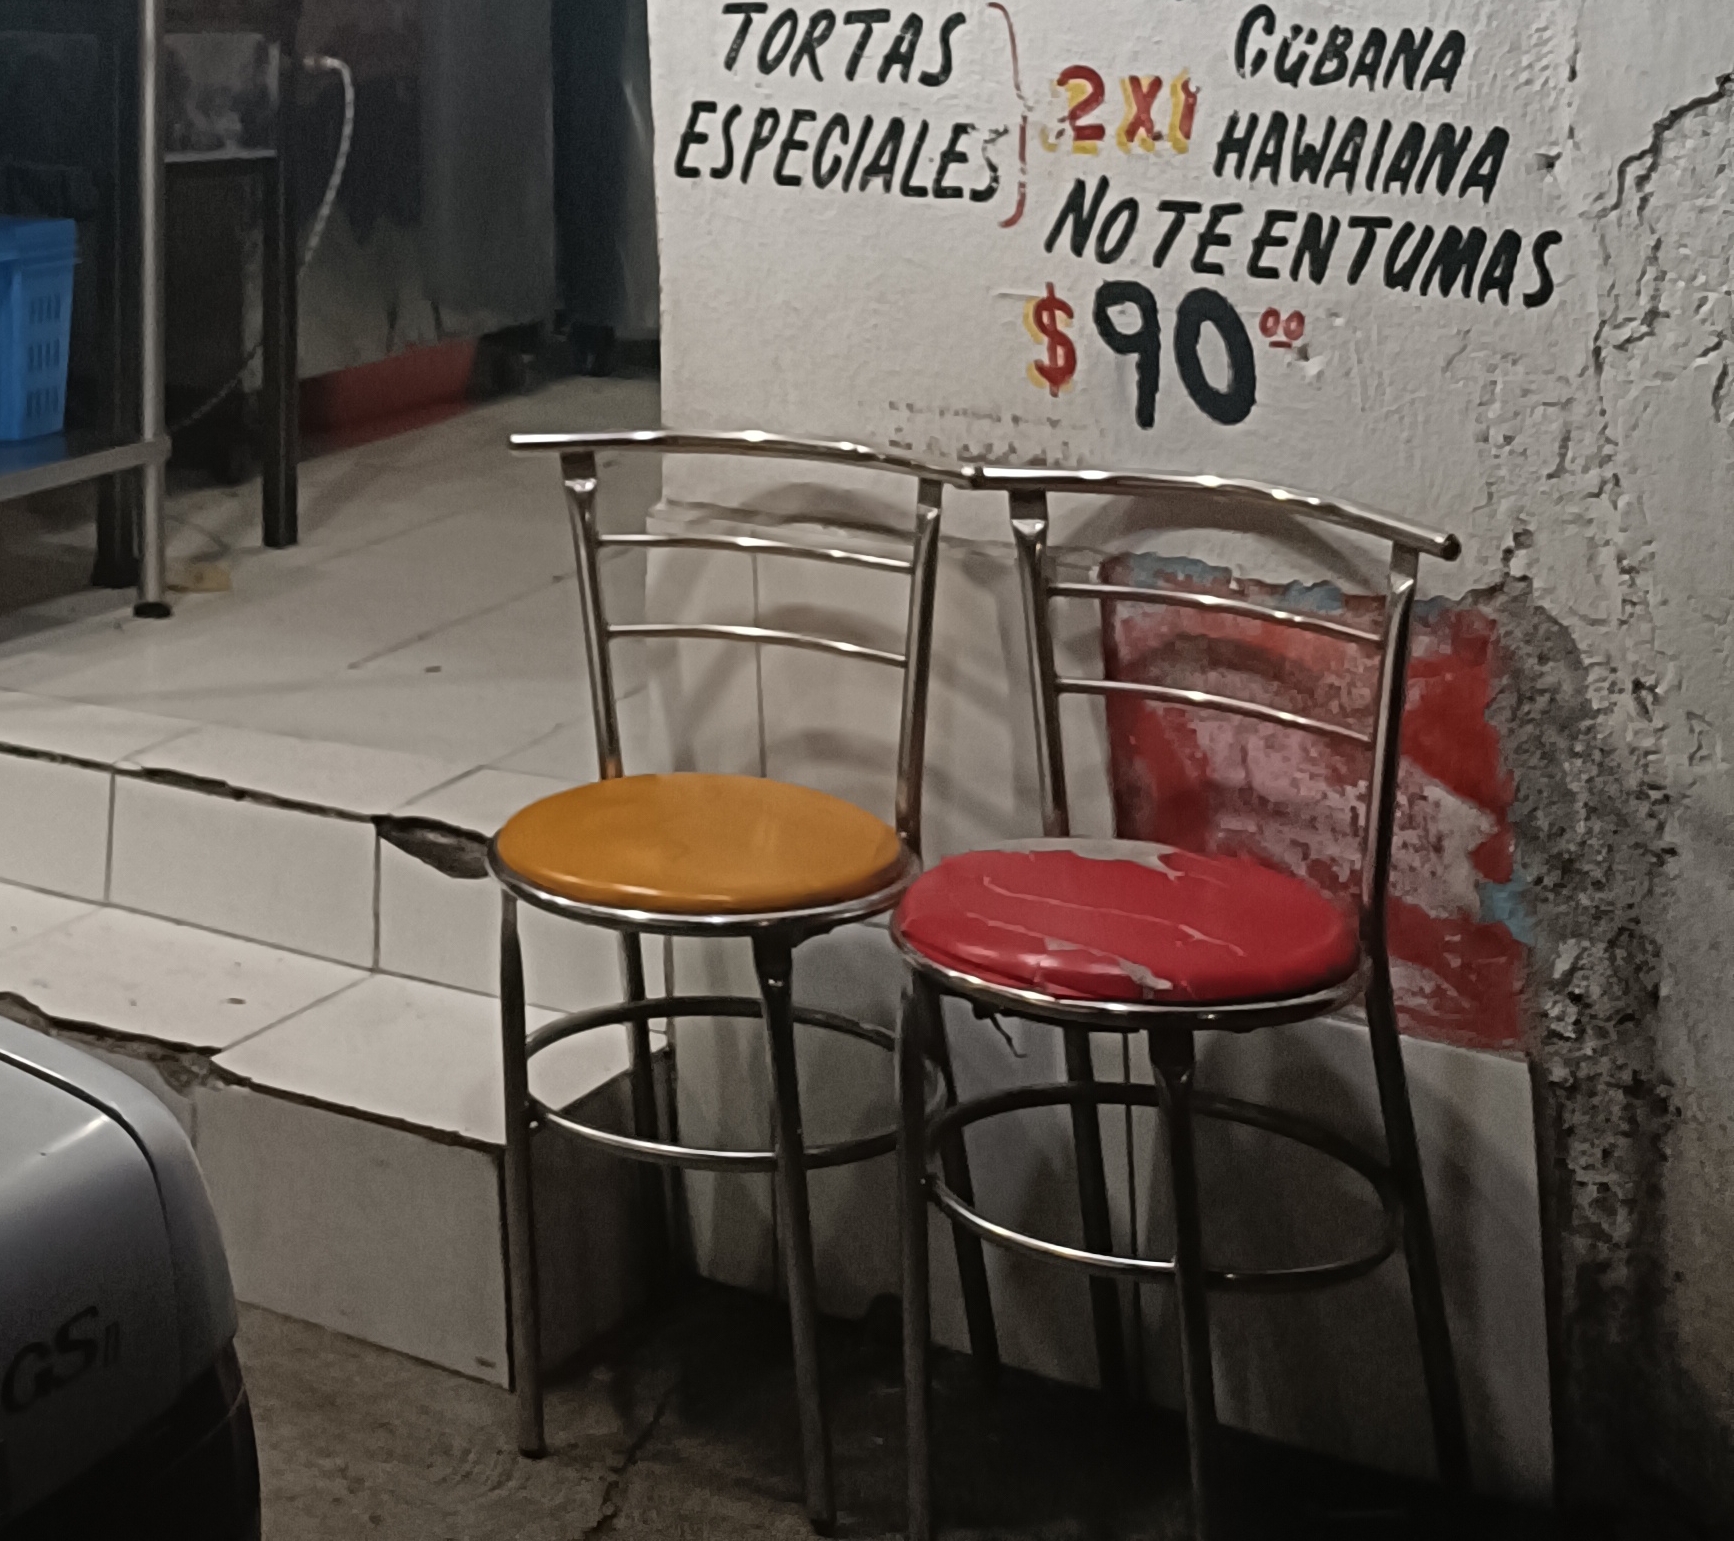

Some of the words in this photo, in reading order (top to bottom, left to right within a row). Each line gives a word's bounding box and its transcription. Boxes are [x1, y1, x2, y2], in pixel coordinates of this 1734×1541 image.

[721, 1, 967, 87] TORTAS
[1051, 64, 1199, 143] 2X1
[673, 100, 1009, 203] ESPECIALES
[1211, 108, 1510, 205] HAWAIANA
[1043, 174, 1140, 264] NO
